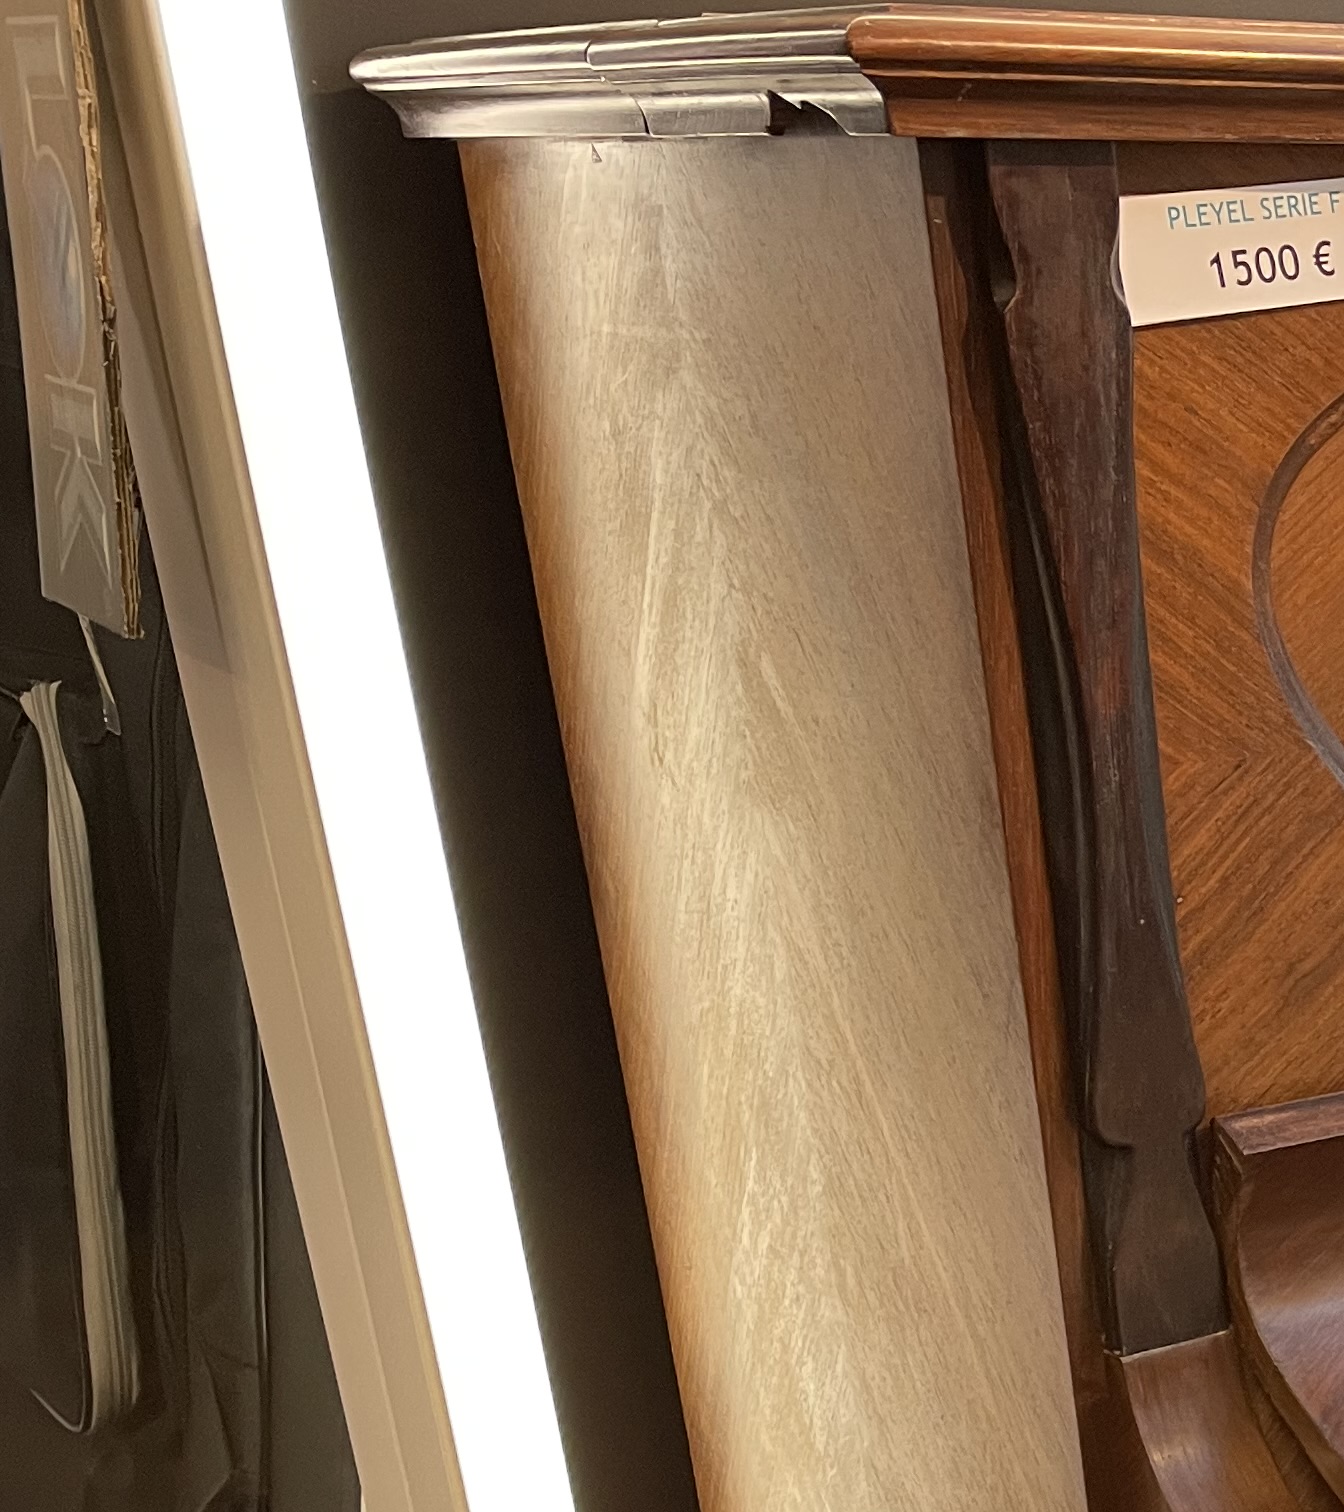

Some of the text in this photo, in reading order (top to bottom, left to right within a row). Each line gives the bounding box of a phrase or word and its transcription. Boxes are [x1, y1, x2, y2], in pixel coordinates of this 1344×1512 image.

[1167, 190, 1341, 230] PLEYEL SERIE F
[1209, 240, 1336, 288] 1500 €
